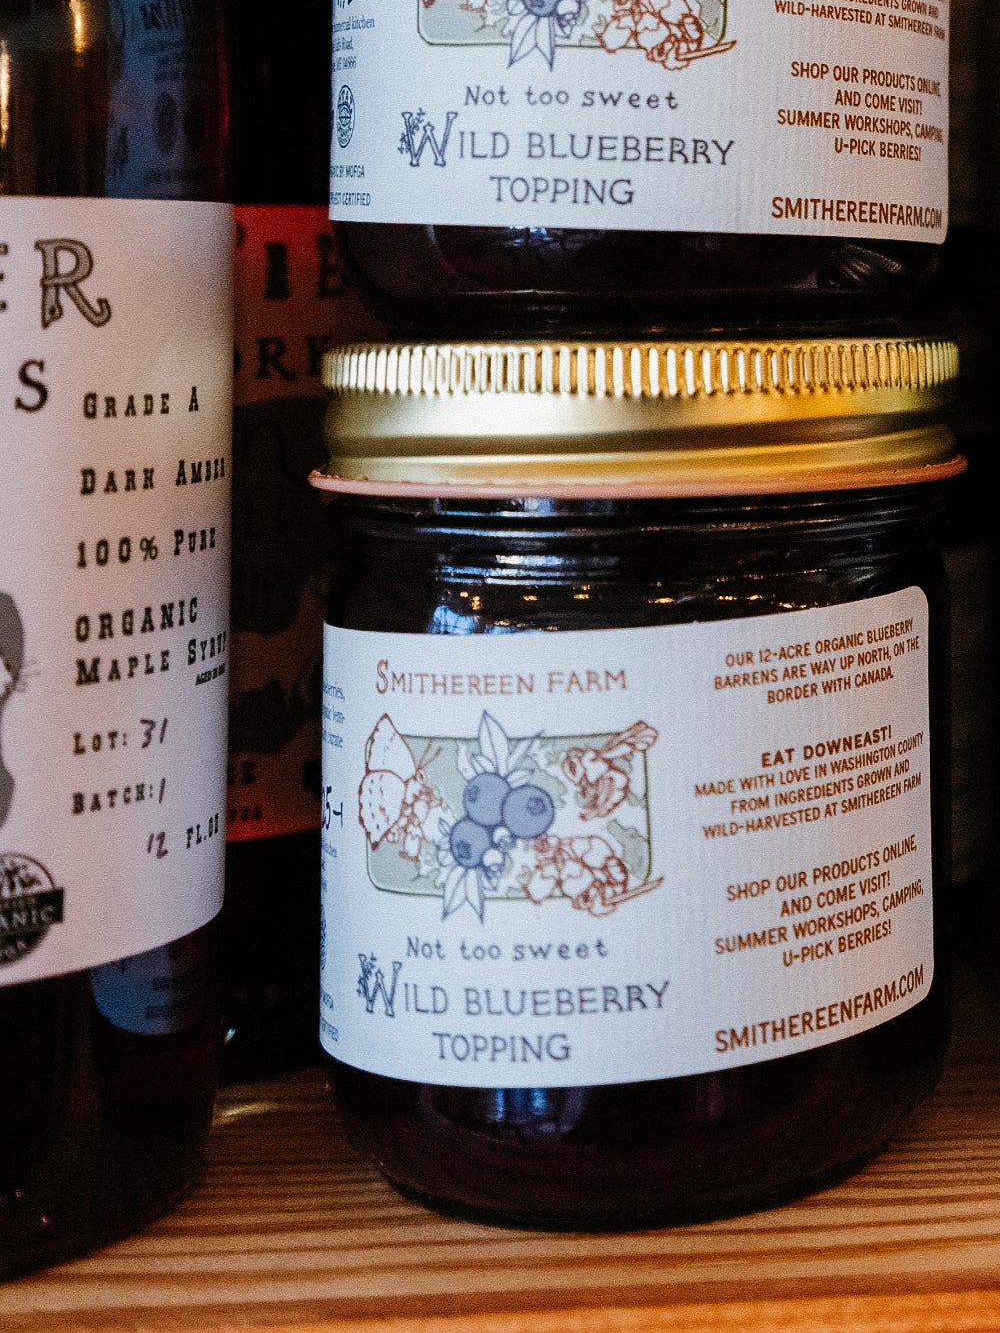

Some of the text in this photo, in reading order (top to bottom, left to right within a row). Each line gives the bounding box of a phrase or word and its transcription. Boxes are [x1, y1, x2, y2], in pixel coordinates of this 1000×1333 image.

[791, 61, 915, 91] SHOP OUR PRODUCTS
[464, 85, 678, 109] Not too sweet
[835, 89, 923, 116] AND COME VISIT!
[400, 109, 510, 167] WILD
[527, 132, 734, 165] BLUEBERRY
[834, 137, 922, 162] U-PICK BERRIES!
[489, 175, 635, 205] TOPPING
[771, 196, 943, 229] SMITHEREENFARM.COM
[188, 385, 199, 413] A
[76, 535, 158, 567] 100%
[74, 596, 199, 643] ORGANIC
[725, 618, 914, 668] OUR 12-ACRE ORGANIC BLUEBERRY
[375, 658, 628, 695] SMITHEREEN FARM
[767, 684, 818, 705] BORDER
[821, 675, 851, 695] WITH
[761, 725, 892, 768] EAT DOWNEAST!
[694, 731, 924, 798] MADE WITH LOVE IN WASHINGTON COUNTY
[702, 772, 922, 840] WILD-HARVESTED AT SMITHEREEN FARM
[726, 879, 771, 902] SHOP
[775, 870, 808, 893] OUR
[812, 850, 880, 885] PRODUCTS
[715, 878, 924, 955] SUMMER WORKSHOPS, CAMPING,
[406, 936, 608, 962] Not too sweet
[358, 955, 670, 1017] WILD BLUEBERRY
[715, 963, 924, 1053] SMITHEREENFARM.COM
[432, 1032, 572, 1062] TOPPING
